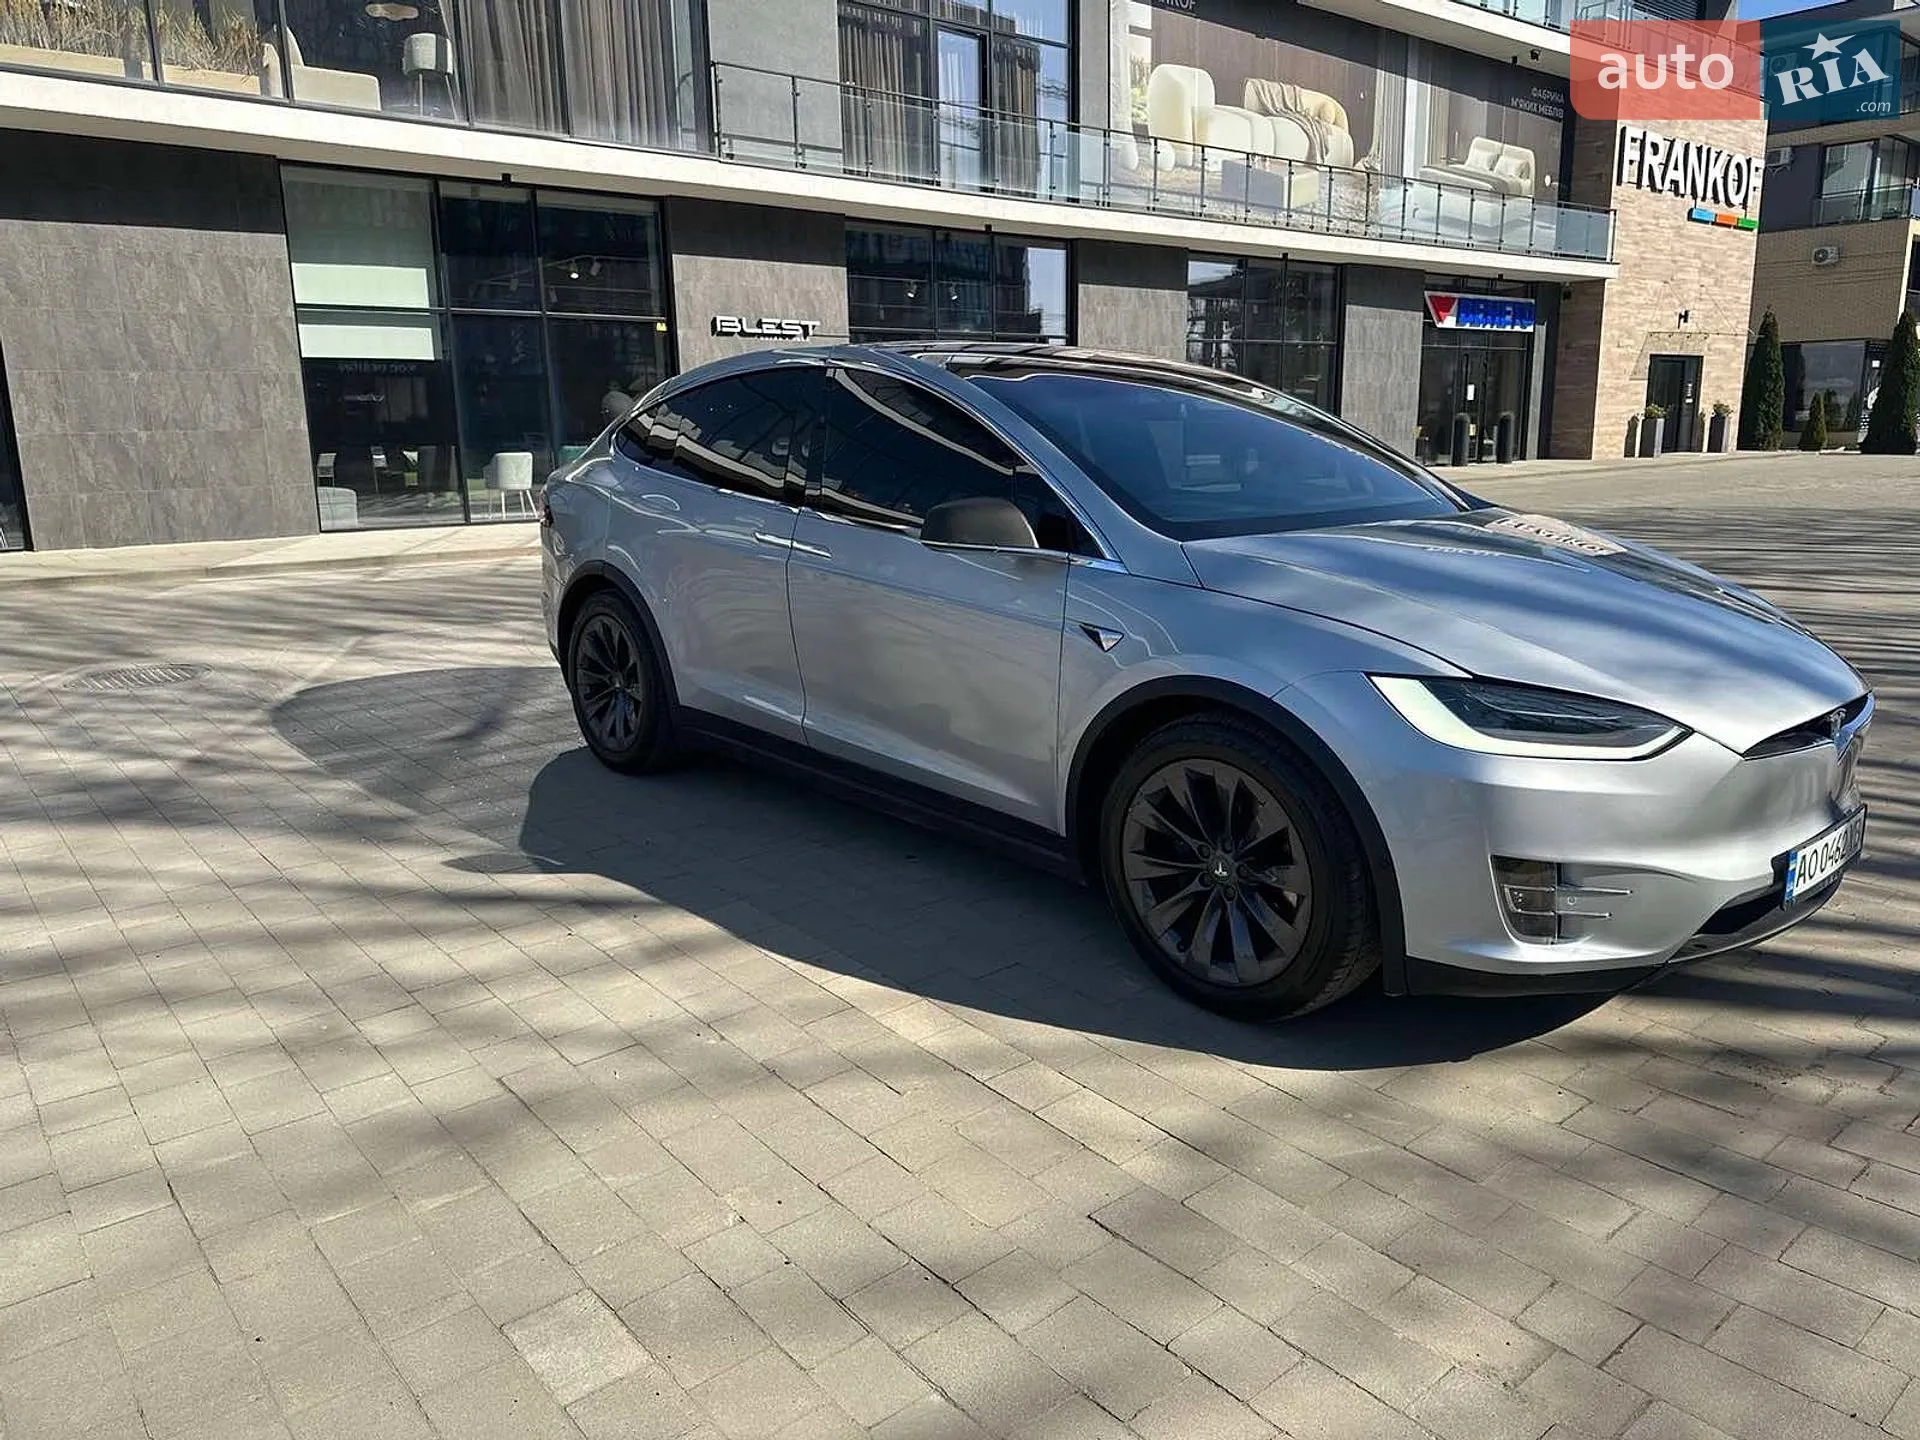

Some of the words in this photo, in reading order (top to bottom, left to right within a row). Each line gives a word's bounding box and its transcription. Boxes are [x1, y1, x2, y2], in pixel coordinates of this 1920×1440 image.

[1620, 126, 1765, 207] FRANKOF
[715, 315, 820, 336] BLEST
[1795, 848, 1818, 888] AO
